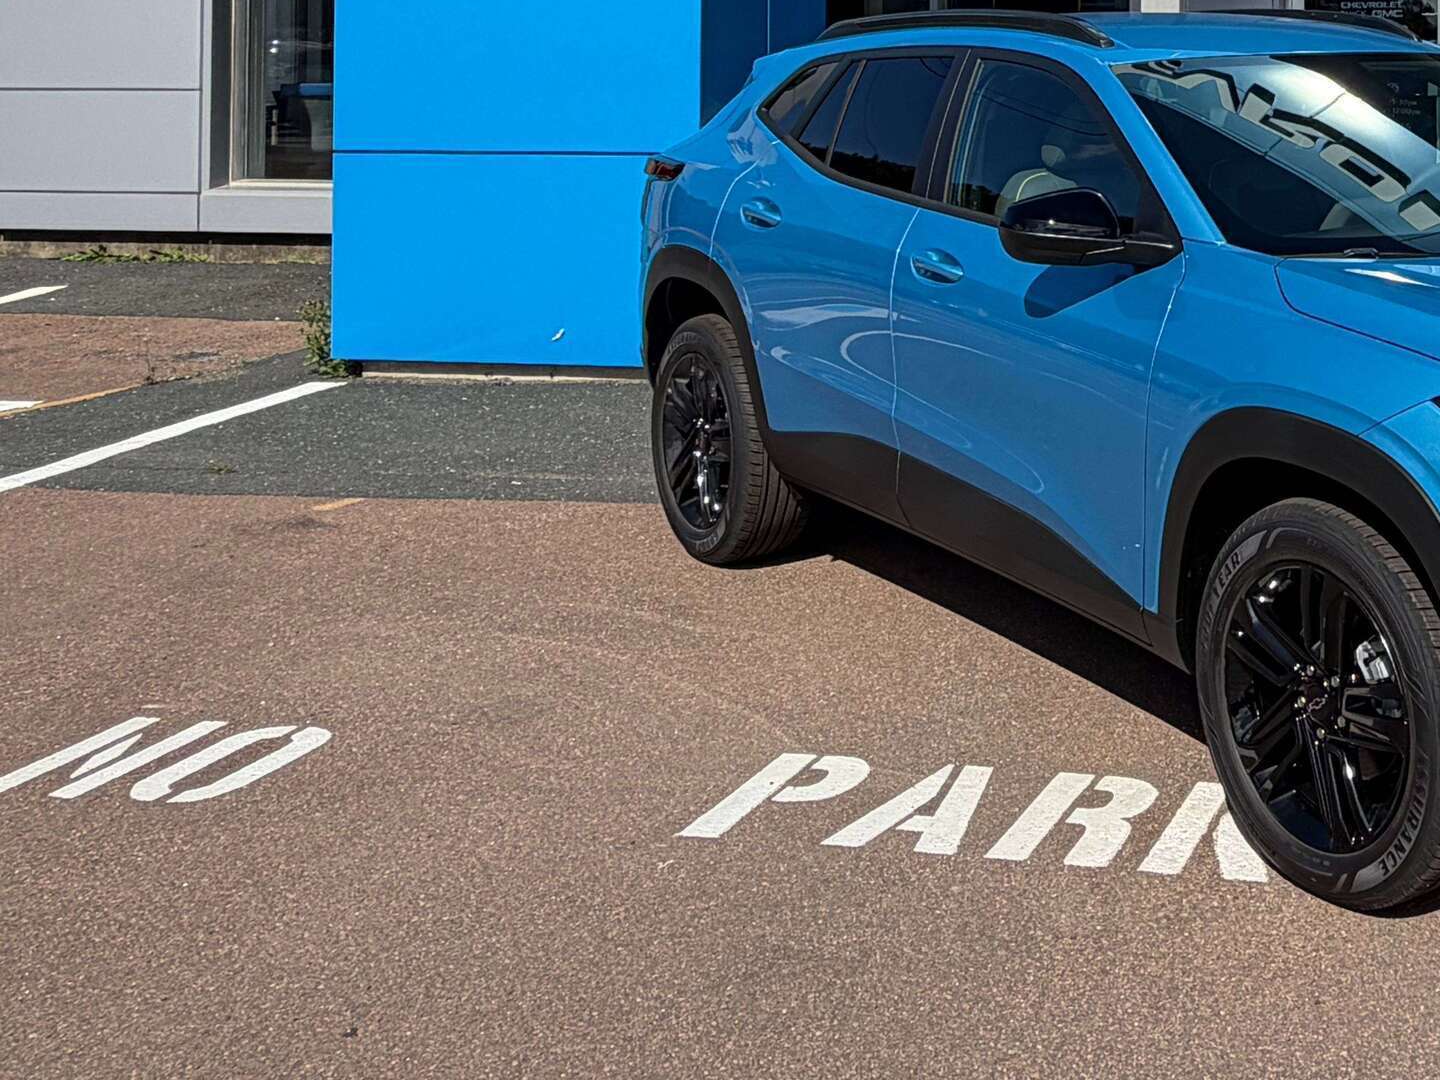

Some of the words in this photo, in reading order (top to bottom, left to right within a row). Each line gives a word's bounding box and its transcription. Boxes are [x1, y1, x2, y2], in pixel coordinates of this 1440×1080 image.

[1340, 1, 1402, 10] CHEVROLET
[1371, 9, 1404, 19] GMC
[0, 717, 332, 803] NO
